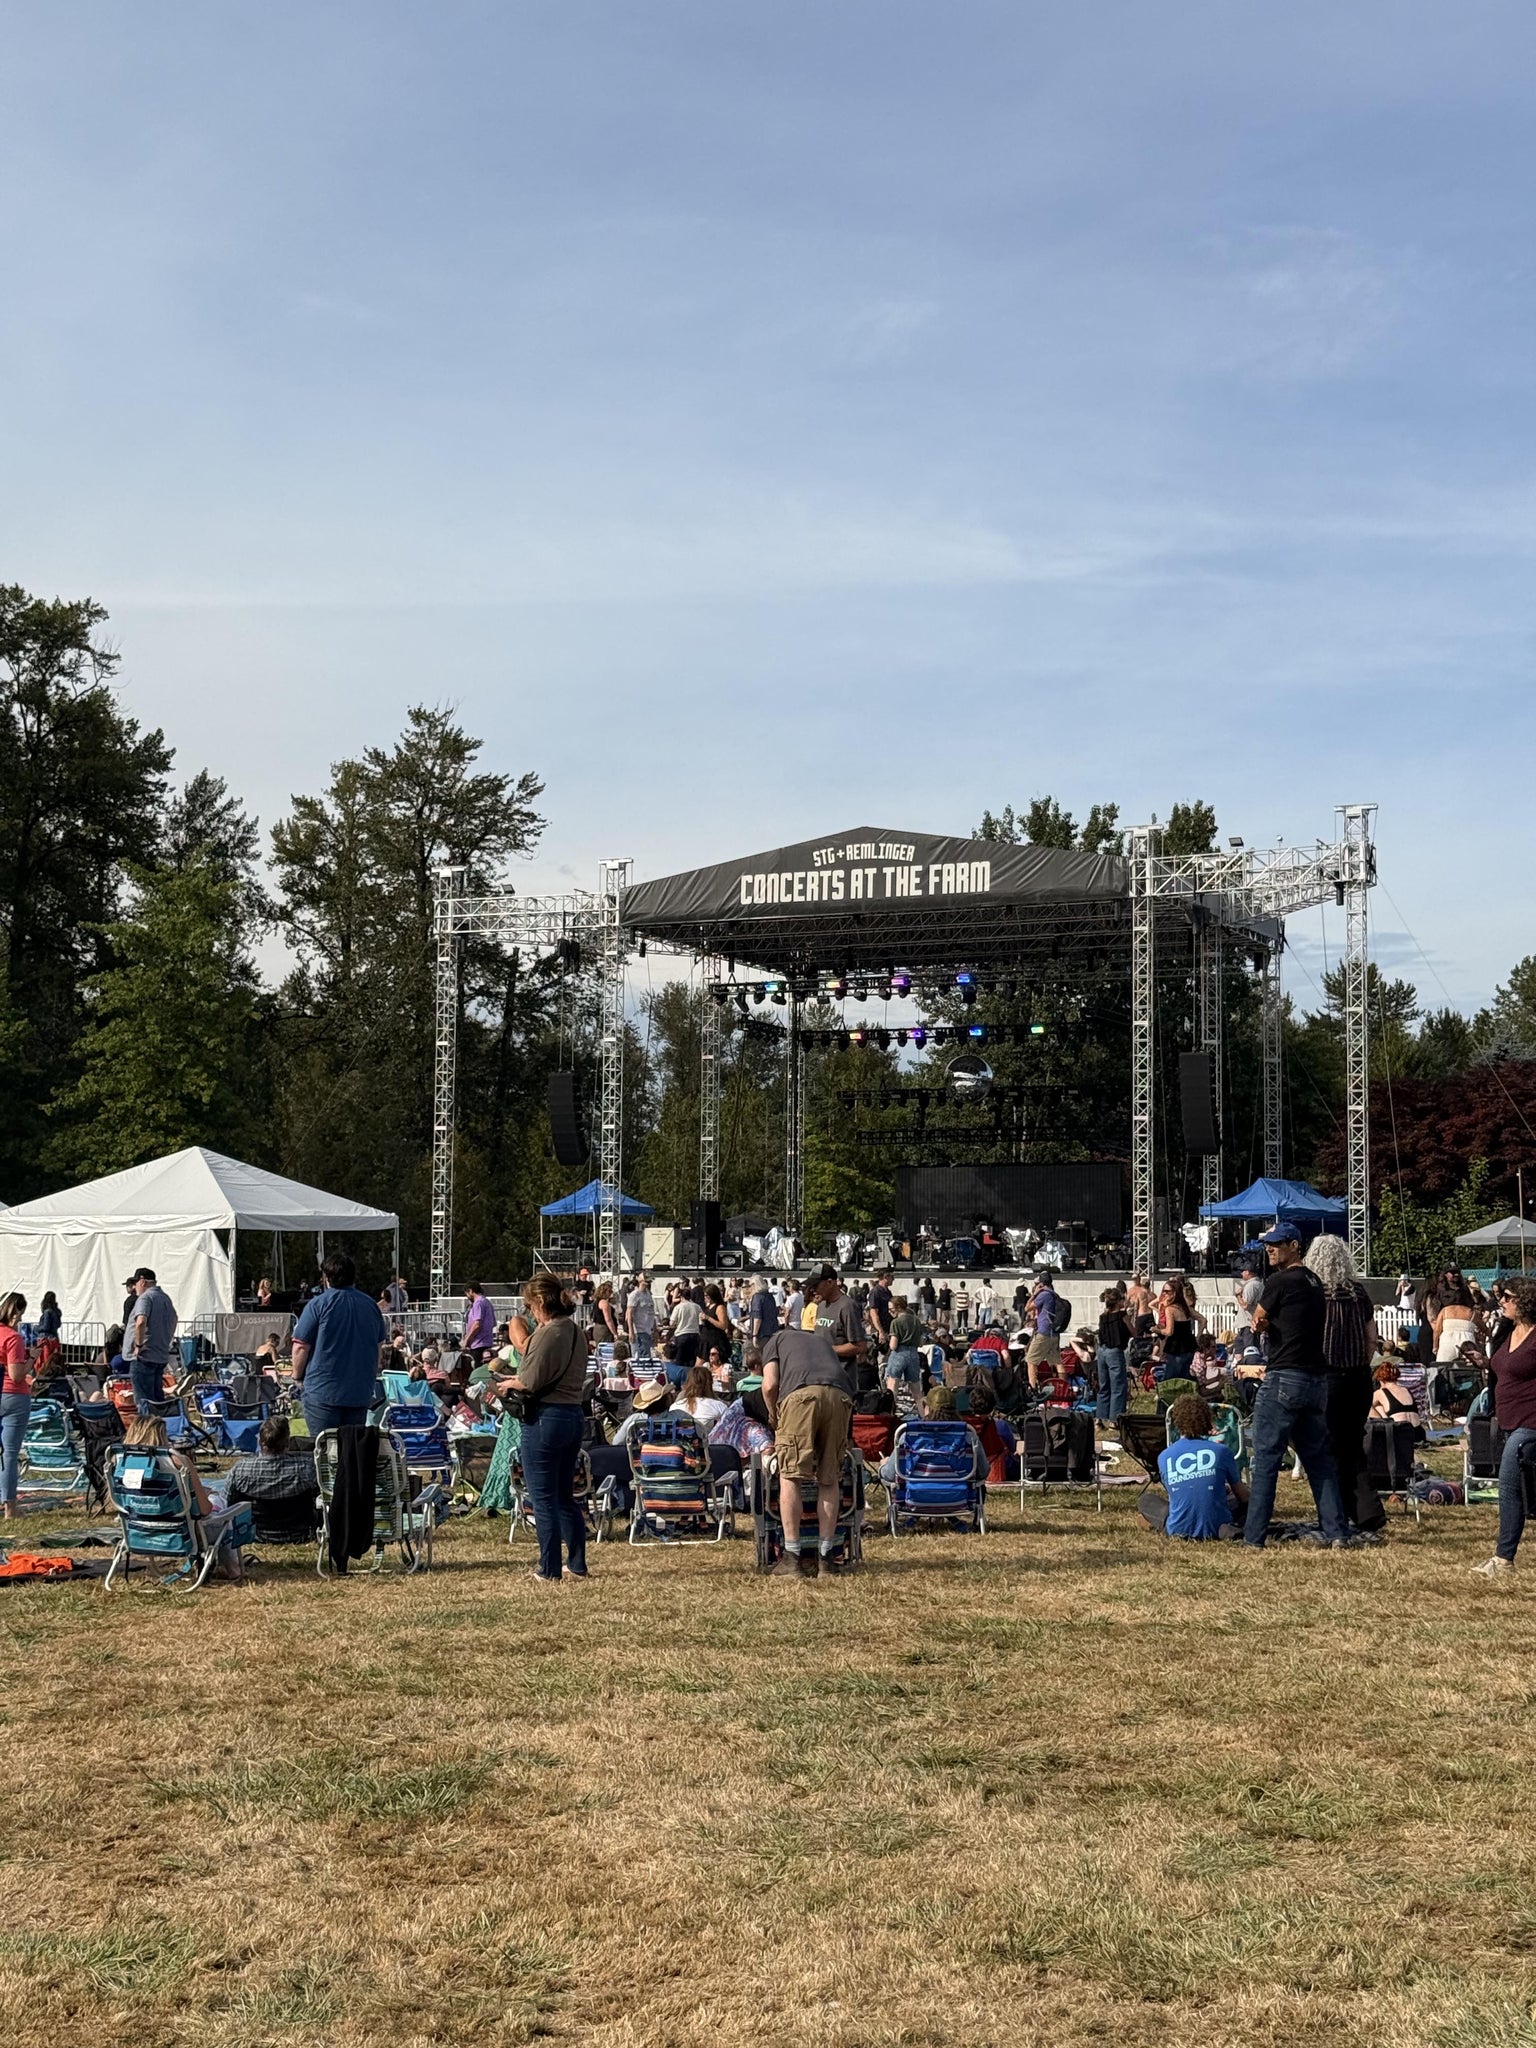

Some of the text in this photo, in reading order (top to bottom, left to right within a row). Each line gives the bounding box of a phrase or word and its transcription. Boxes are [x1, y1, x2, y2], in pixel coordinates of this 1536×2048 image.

[740, 861, 991, 905] CONCERTS AT THE FARM
[1166, 1449, 1216, 1478] LCD
[1167, 1468, 1216, 1486] SOUNDSYSTEM
